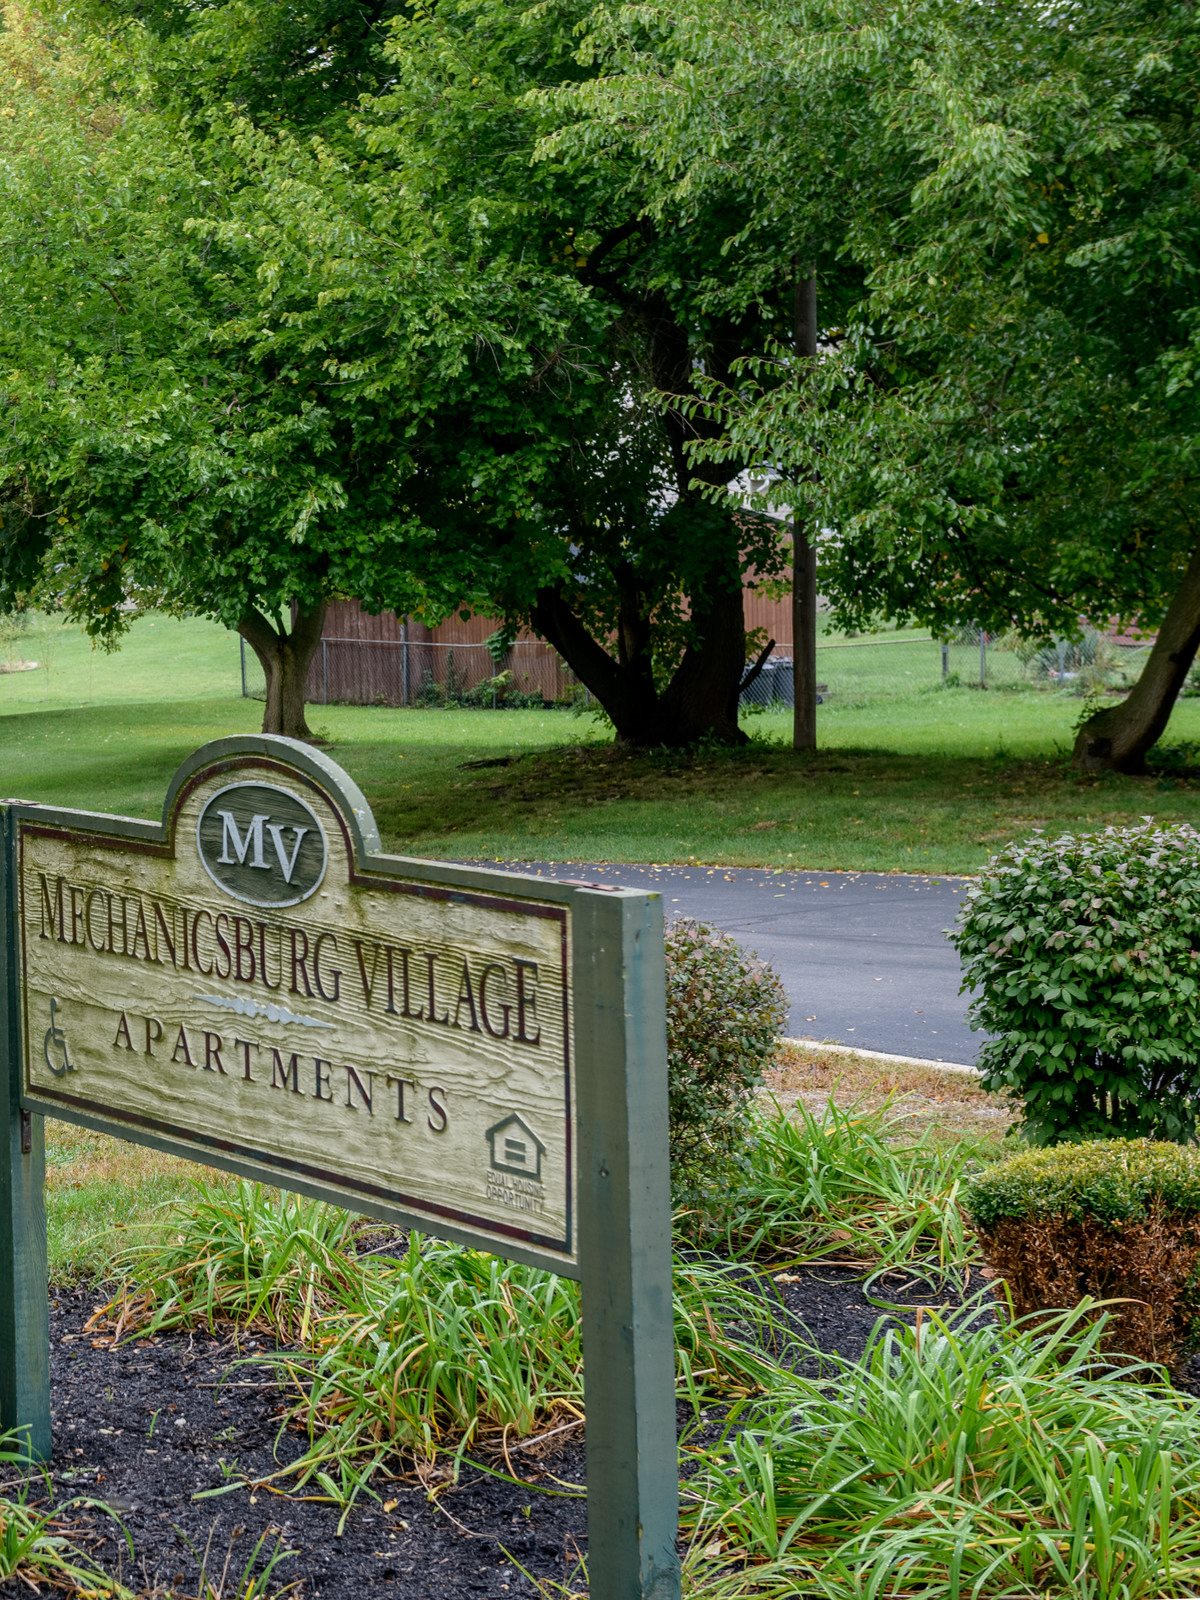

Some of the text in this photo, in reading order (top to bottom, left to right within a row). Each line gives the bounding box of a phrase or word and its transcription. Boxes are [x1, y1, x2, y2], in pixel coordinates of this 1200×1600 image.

[216, 810, 308, 884] MV
[37, 872, 542, 1046] MECHANICSBURG VILLAGE
[112, 1010, 448, 1132] APARTMENTS
[486, 1184, 545, 1213] OPPORTUNITY
